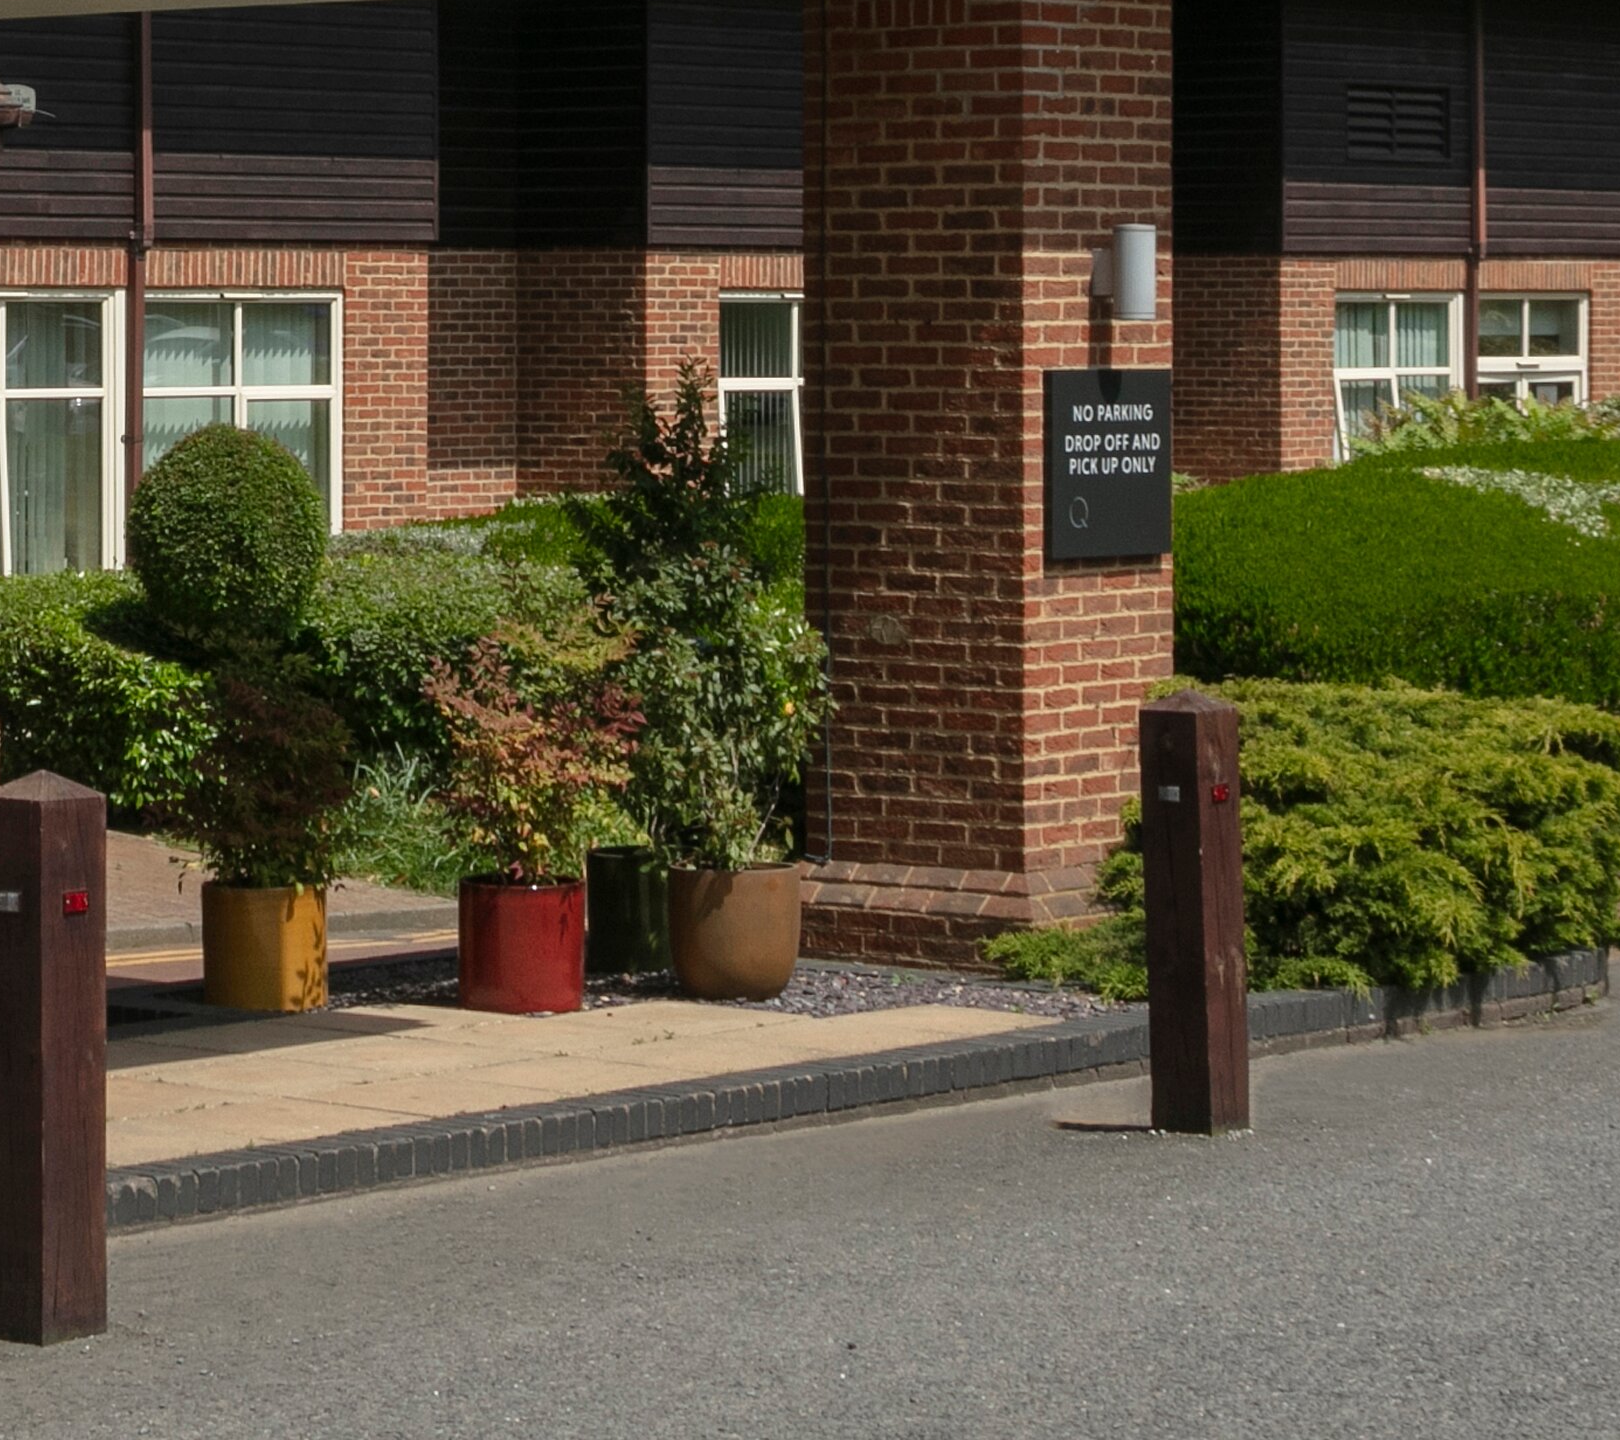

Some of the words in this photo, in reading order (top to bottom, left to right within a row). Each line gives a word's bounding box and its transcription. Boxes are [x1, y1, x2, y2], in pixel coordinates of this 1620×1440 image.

[1073, 405, 1094, 422] NO
[1097, 404, 1154, 422] PARKING
[1065, 435, 1101, 452] DROP
[1104, 434, 1130, 451] OFF
[1132, 433, 1161, 451] AND
[1069, 458, 1098, 475] PICK
[1101, 457, 1119, 475] UP
[1121, 456, 1156, 473] ONLY
[1069, 496, 1089, 528] Q
